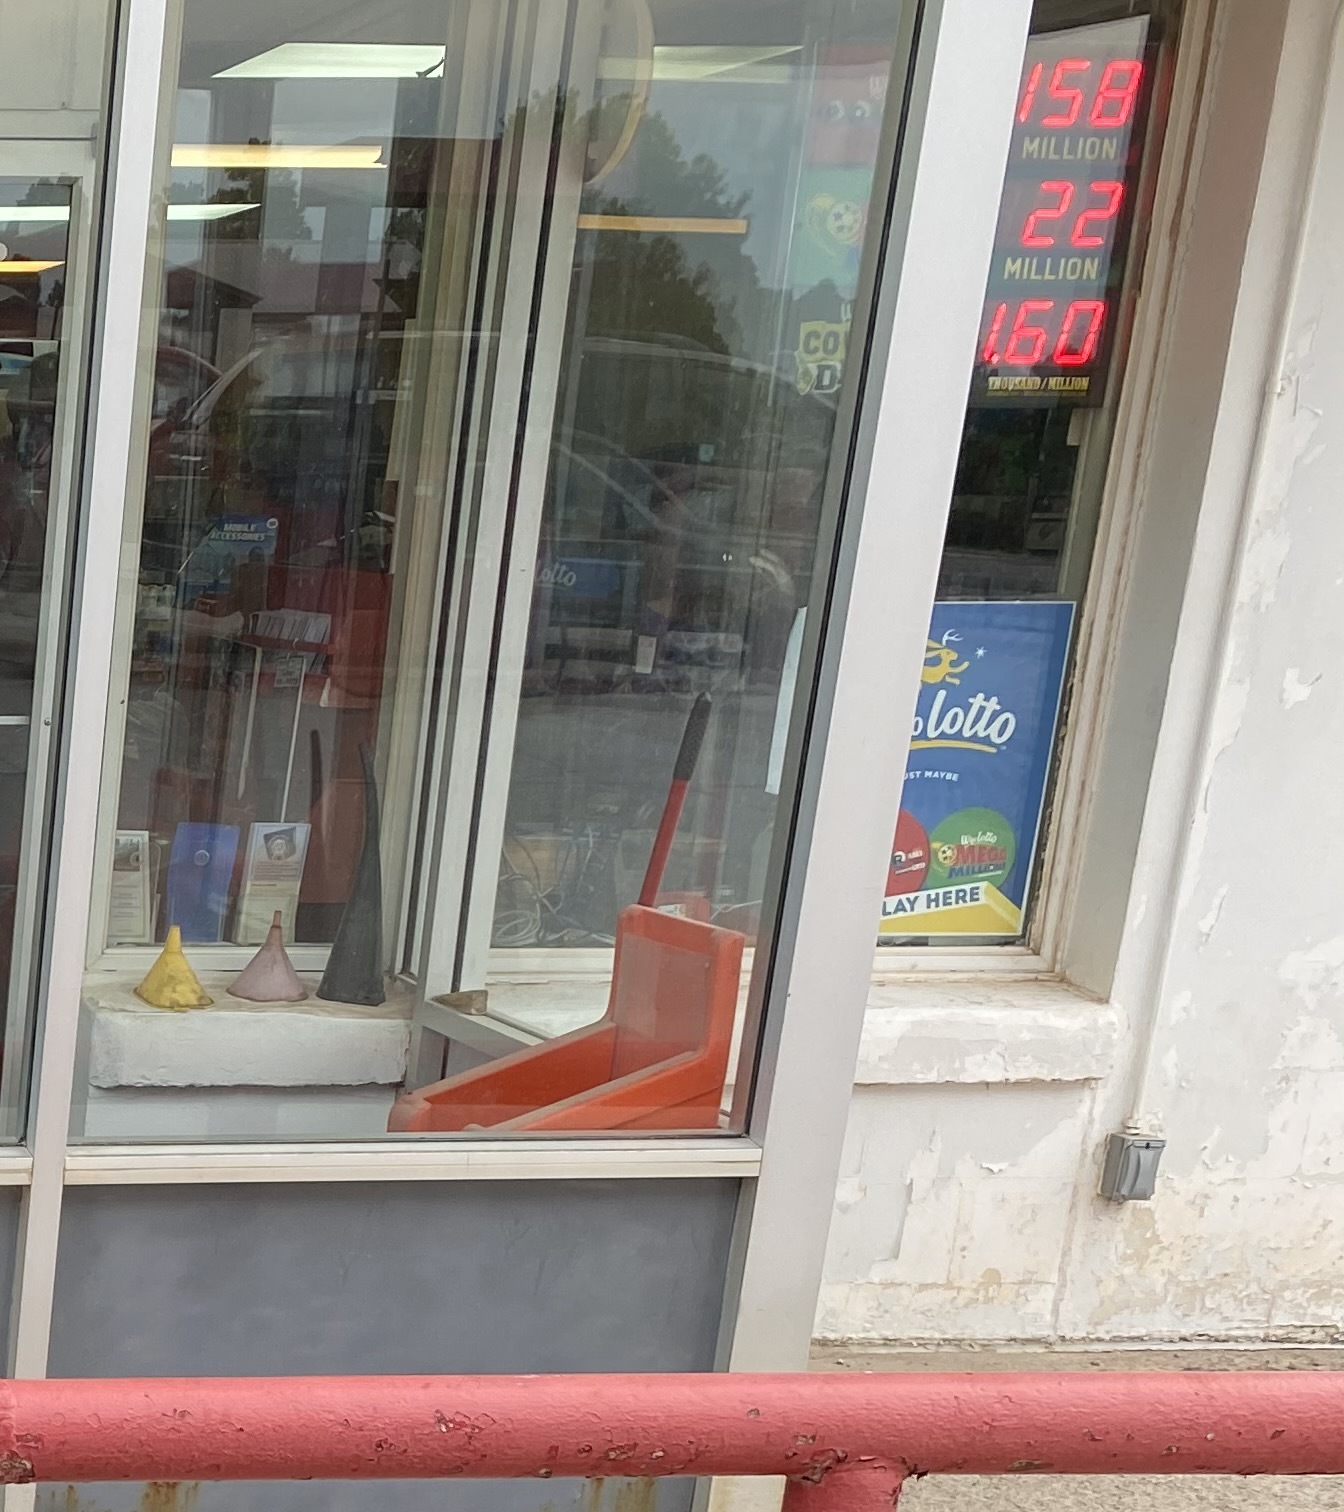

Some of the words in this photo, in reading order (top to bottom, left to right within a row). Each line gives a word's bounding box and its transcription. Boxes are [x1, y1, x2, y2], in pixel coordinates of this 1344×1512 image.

[1017, 59, 1144, 128] 158
[1022, 137, 1117, 160] MILLION
[1020, 179, 1124, 248] 22
[1004, 257, 1100, 281] MILLION
[924, 770, 960, 782] MAYBE
[926, 886, 980, 909] HERE
